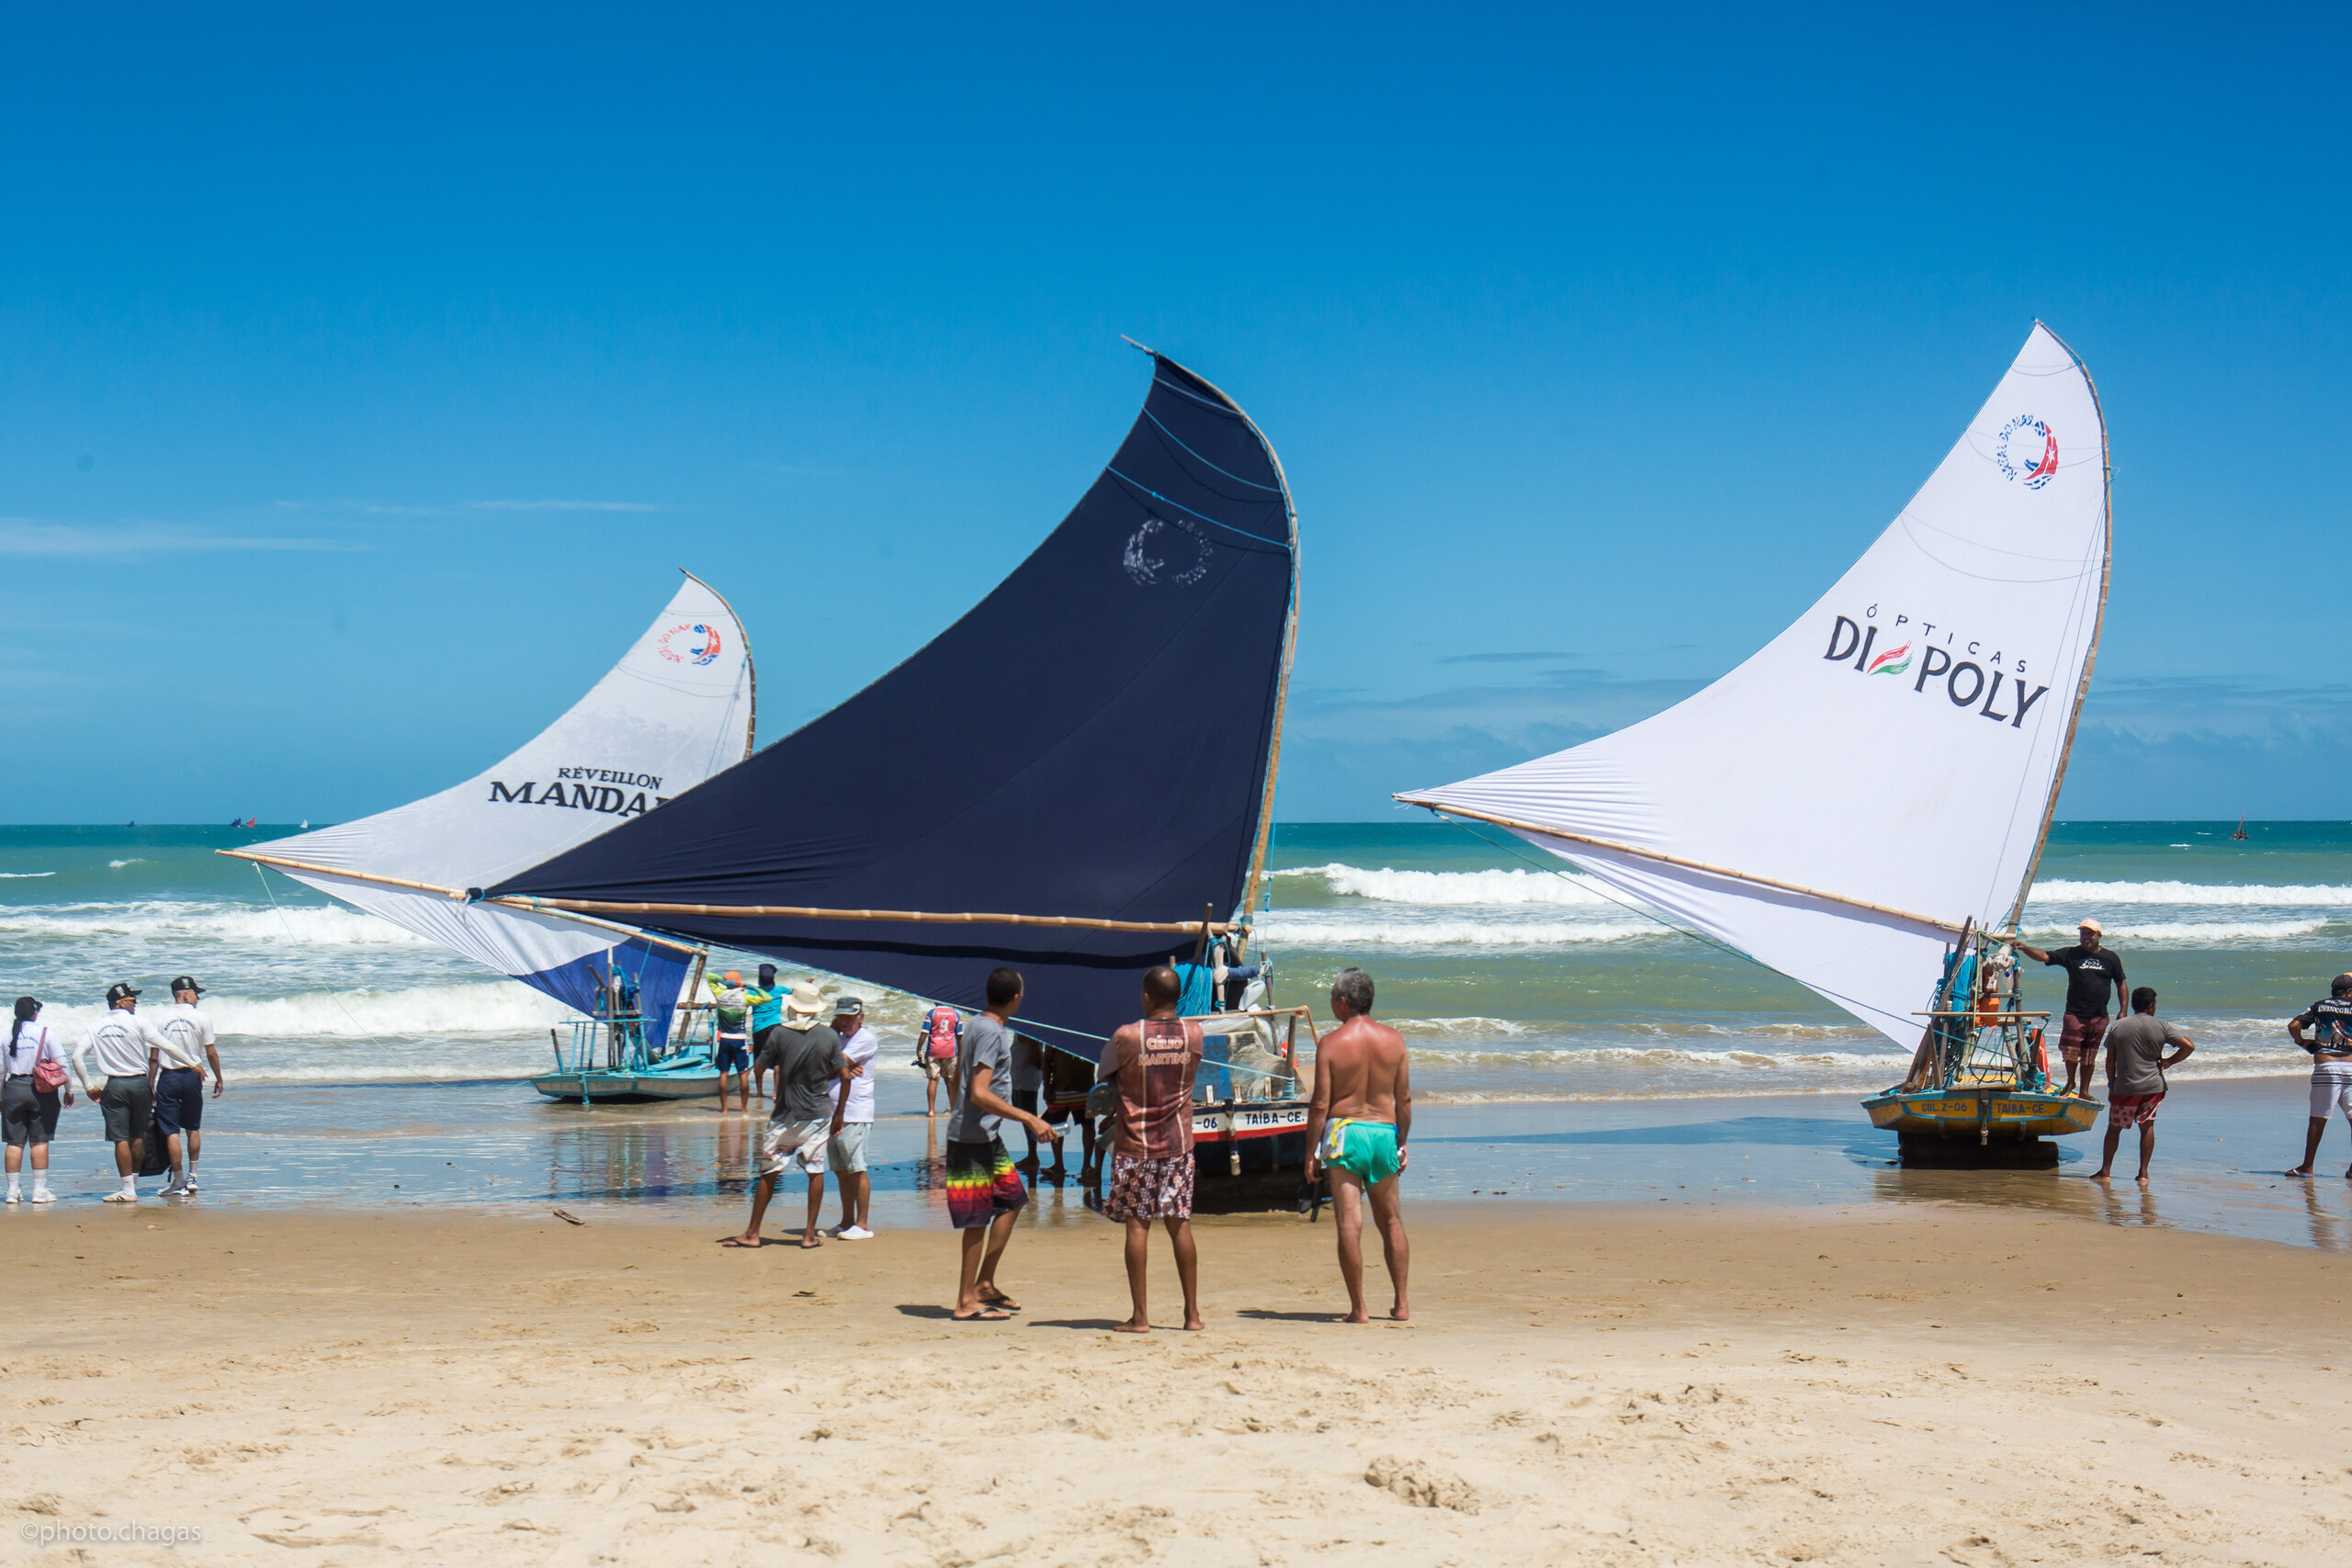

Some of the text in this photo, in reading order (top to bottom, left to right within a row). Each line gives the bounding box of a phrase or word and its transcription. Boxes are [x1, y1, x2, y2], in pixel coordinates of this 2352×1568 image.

[1866, 604, 2027, 673] ÓPTICAS
[557, 766, 662, 791] RÉVEILLON
[488, 781, 672, 818] MANDA
[939, 1019, 949, 1034] 9
[1146, 1034, 1184, 1051] CÉLIO
[1138, 1052, 1192, 1066] MARTINS
